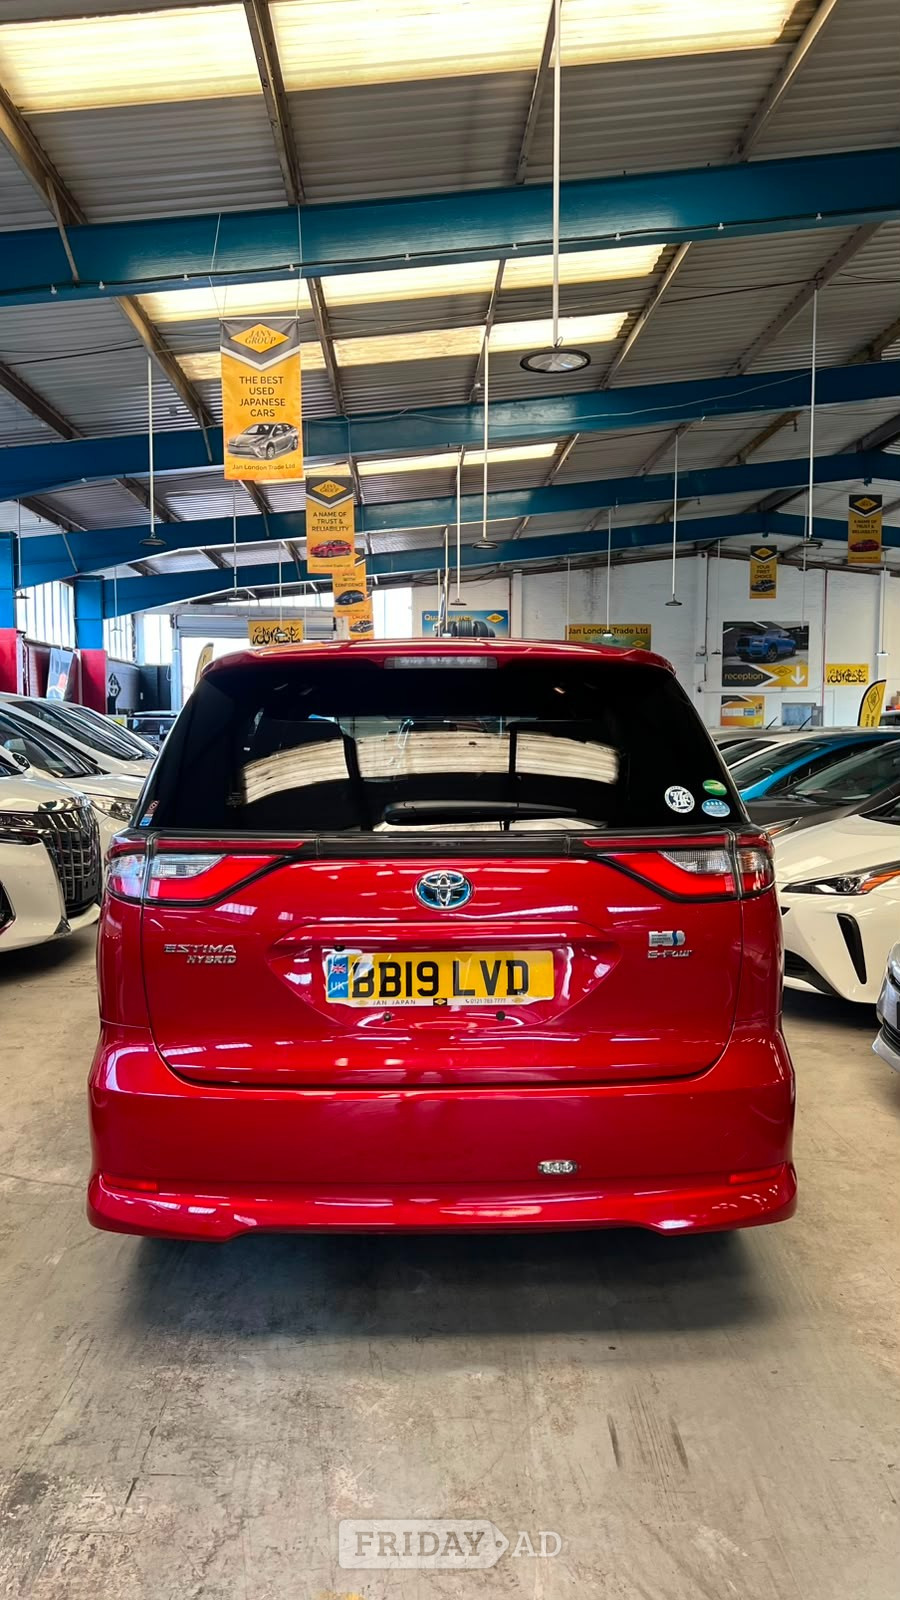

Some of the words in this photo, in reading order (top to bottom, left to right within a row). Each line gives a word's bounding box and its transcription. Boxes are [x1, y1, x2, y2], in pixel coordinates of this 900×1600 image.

[239, 376, 258, 384] THE
[260, 376, 284, 384] BEST
[249, 387, 275, 395] USED
[240, 398, 286, 406] JAPANESE
[250, 409, 275, 417] CARS
[724, 671, 763, 681] reception
[164, 944, 237, 953] ESTIMA
[186, 955, 237, 964] HYBRID
[352, 961, 439, 998] BB19
[452, 960, 530, 996] LVD
[330, 981, 345, 991] UK
